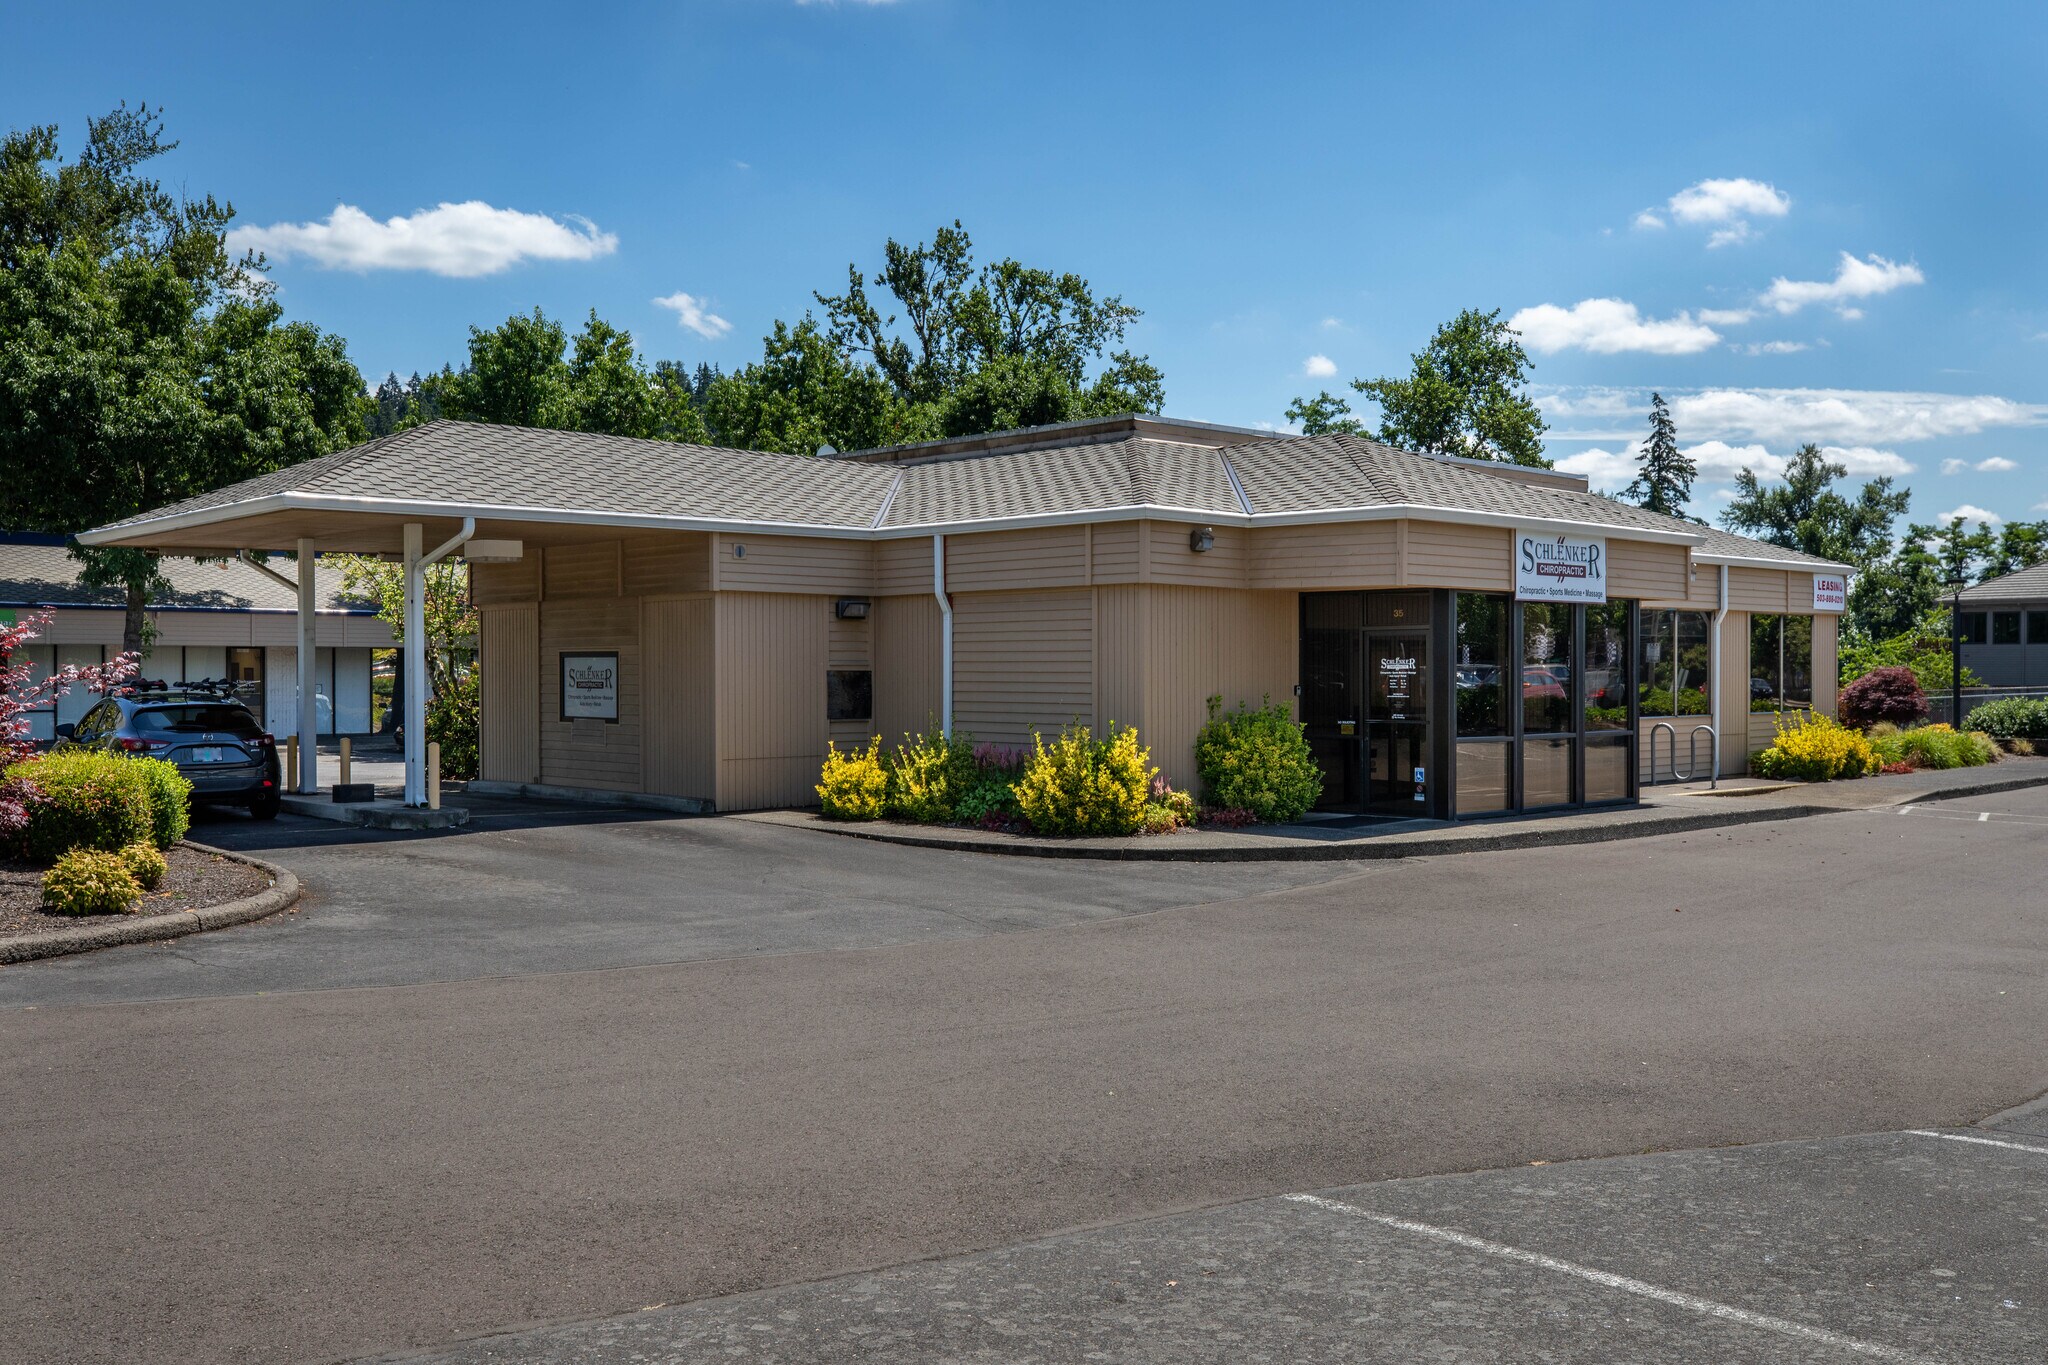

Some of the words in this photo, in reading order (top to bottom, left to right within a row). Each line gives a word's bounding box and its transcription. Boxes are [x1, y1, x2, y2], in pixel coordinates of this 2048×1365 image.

[1522, 538, 1601, 580] SCHLENKER
[1540, 564, 1583, 576] CHIROPRACTIC
[1519, 585, 1546, 596] Chiropractic
[1549, 587, 1563, 597] Sports
[1564, 589, 1582, 597] Medicine
[1585, 590, 1603, 599] Massage
[1818, 580, 1842, 592] LEASING
[1393, 609, 1404, 618] 35
